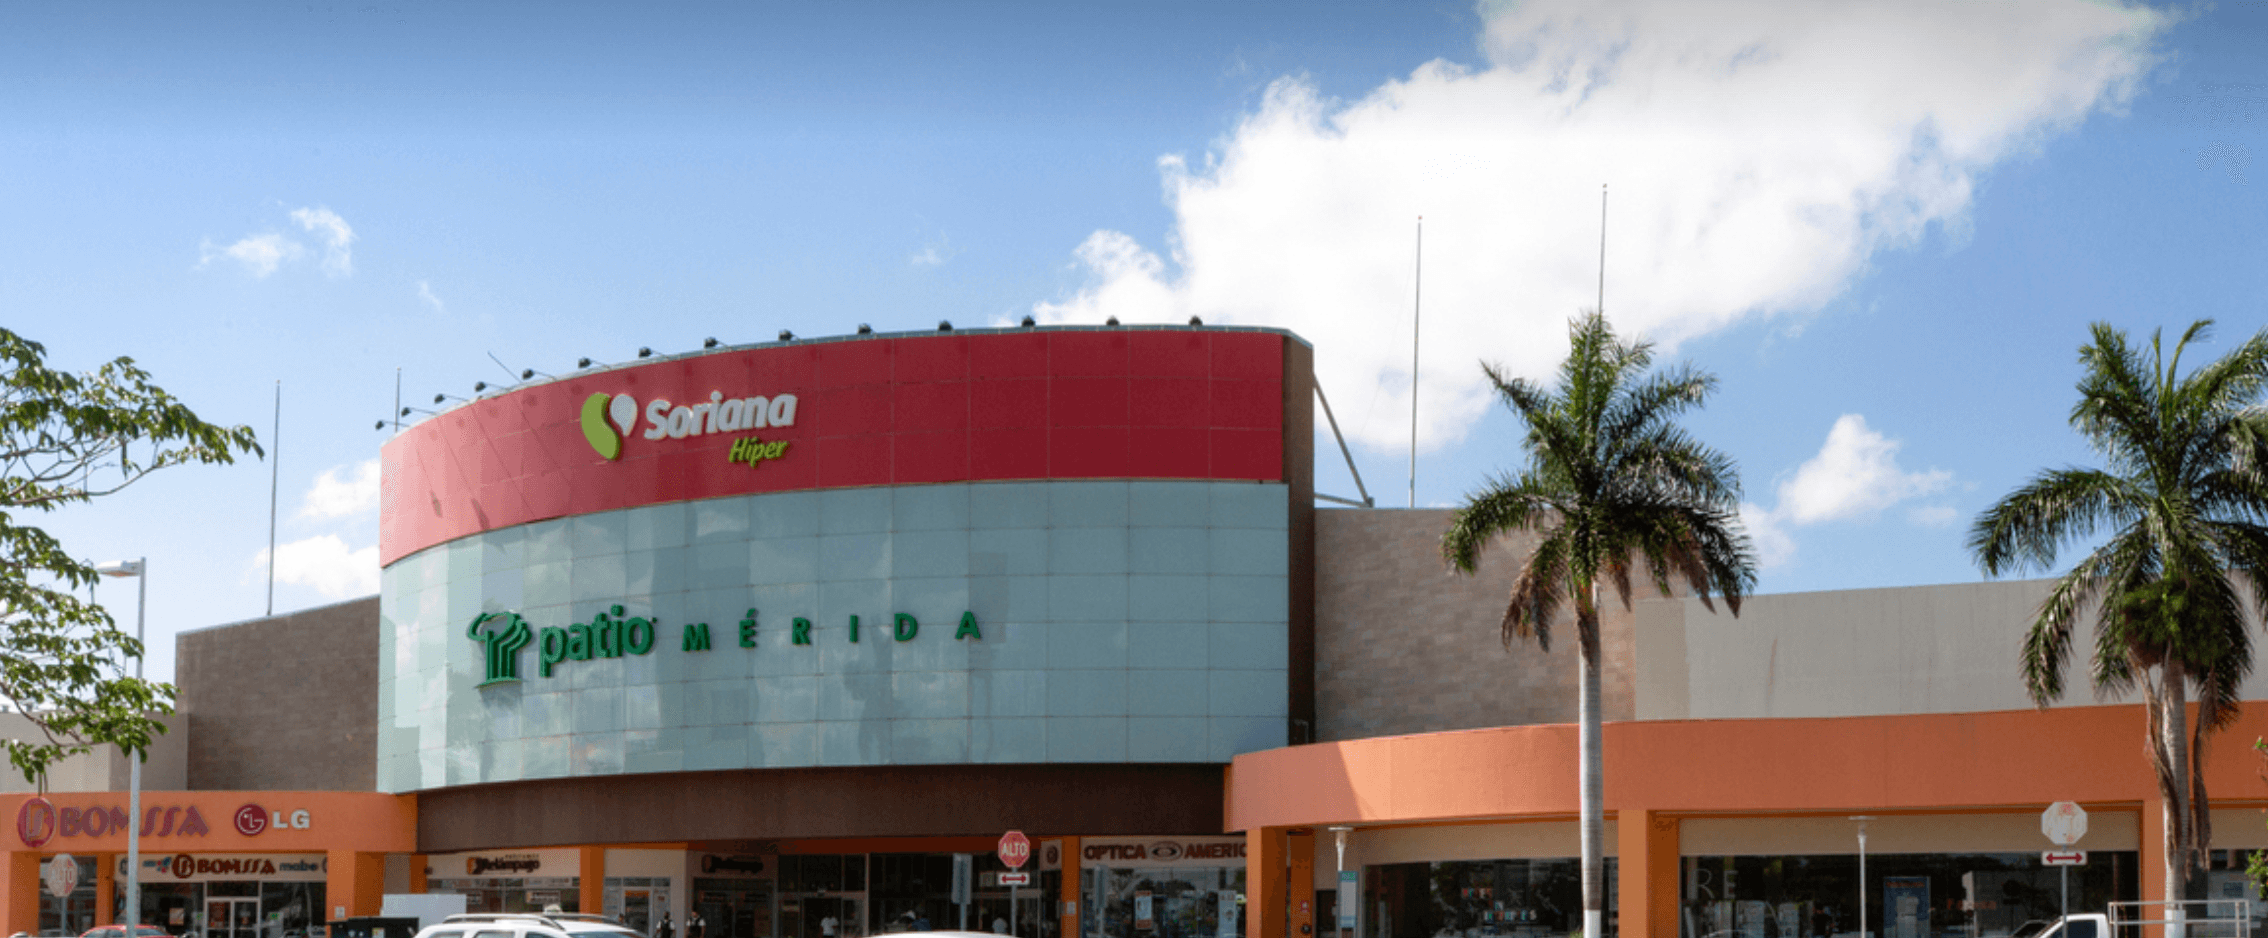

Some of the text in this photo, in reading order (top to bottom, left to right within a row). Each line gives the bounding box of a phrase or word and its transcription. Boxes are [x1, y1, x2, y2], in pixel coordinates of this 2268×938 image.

[643, 390, 799, 440] Soriana
[538, 604, 982, 678] patio MÉRIDA
[59, 805, 311, 837] BOMSSA LG
[1002, 842, 1028, 856] ALTO
[1083, 844, 1147, 860] OPTICA
[196, 858, 319, 875] BOMSSA mabe
